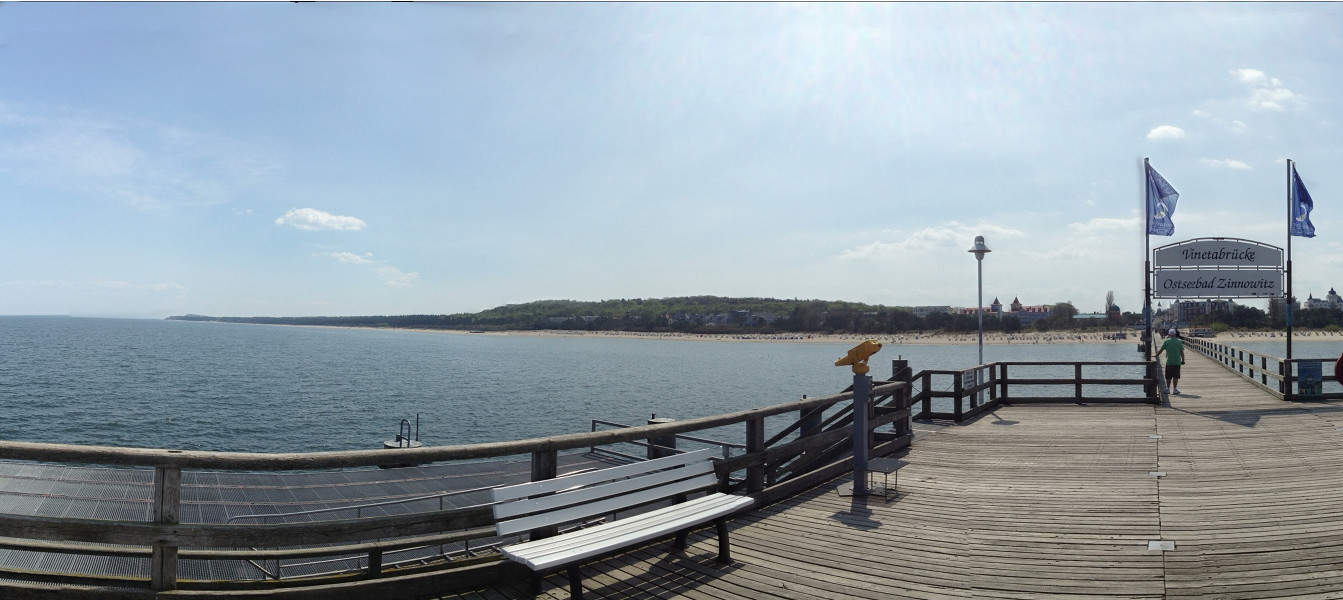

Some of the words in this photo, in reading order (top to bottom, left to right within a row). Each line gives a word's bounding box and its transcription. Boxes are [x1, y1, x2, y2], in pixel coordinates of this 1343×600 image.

[1182, 247, 1255, 262] Vinetabrücke
[1163, 277, 1217, 289] Ostseebad
[1217, 278, 1275, 289] Zinnowitz
